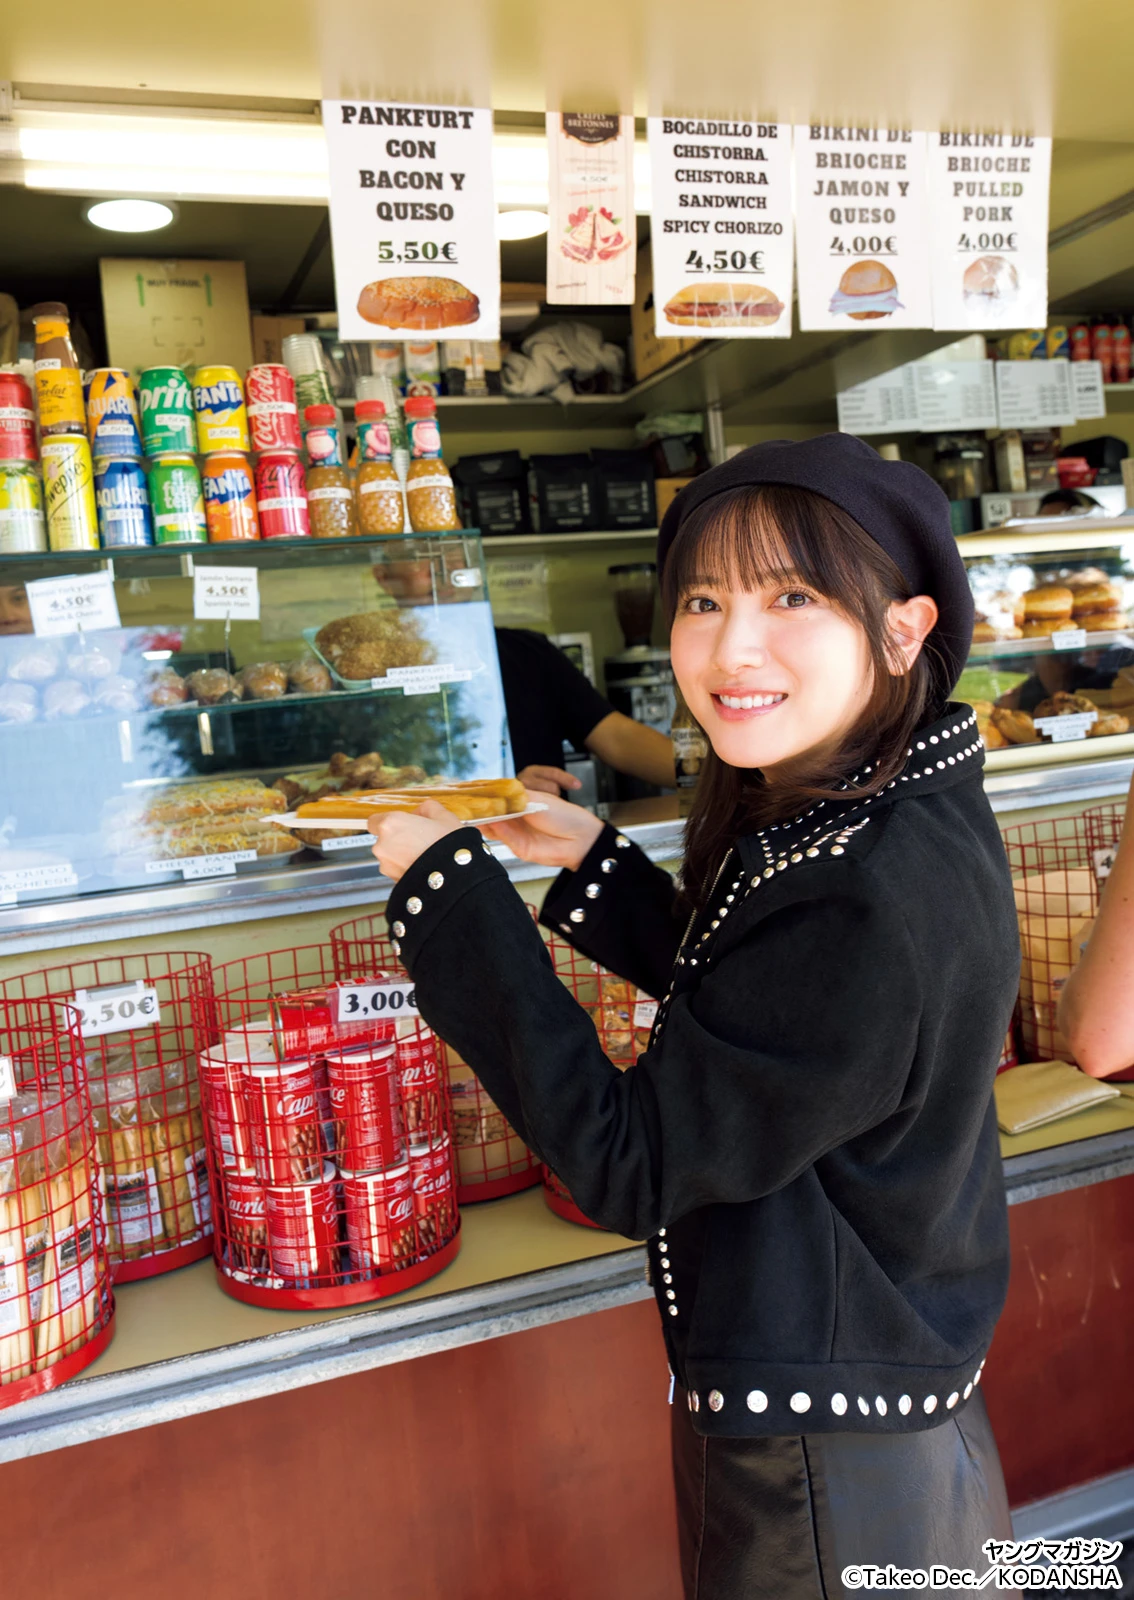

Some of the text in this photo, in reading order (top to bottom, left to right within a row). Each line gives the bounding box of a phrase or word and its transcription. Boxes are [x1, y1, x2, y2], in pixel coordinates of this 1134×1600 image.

[341, 104, 474, 130] PANKFURT
[662, 120, 778, 138] BOCADILLO DE
[809, 125, 912, 143] BIKINI DE
[386, 139, 436, 159] CON
[939, 132, 1003, 148] BIKINI
[815, 152, 906, 170] BRIOCHE
[947, 156, 1031, 172] BRIOCHE
[359, 169, 465, 191] BACON Y
[675, 169, 769, 185] CHISTORRA
[813, 180, 910, 198] JAMON Y
[953, 182, 1024, 198] PULLED
[679, 194, 767, 209] SANDWICH
[376, 201, 454, 221] QUESO
[829, 208, 896, 225] QUESO
[963, 206, 1013, 222] PORK
[663, 220, 783, 235] SPICY CHORIZO
[378, 240, 458, 265] 5,50€
[829, 235, 898, 256] 4,00€
[685, 249, 765, 274] 4,50€
